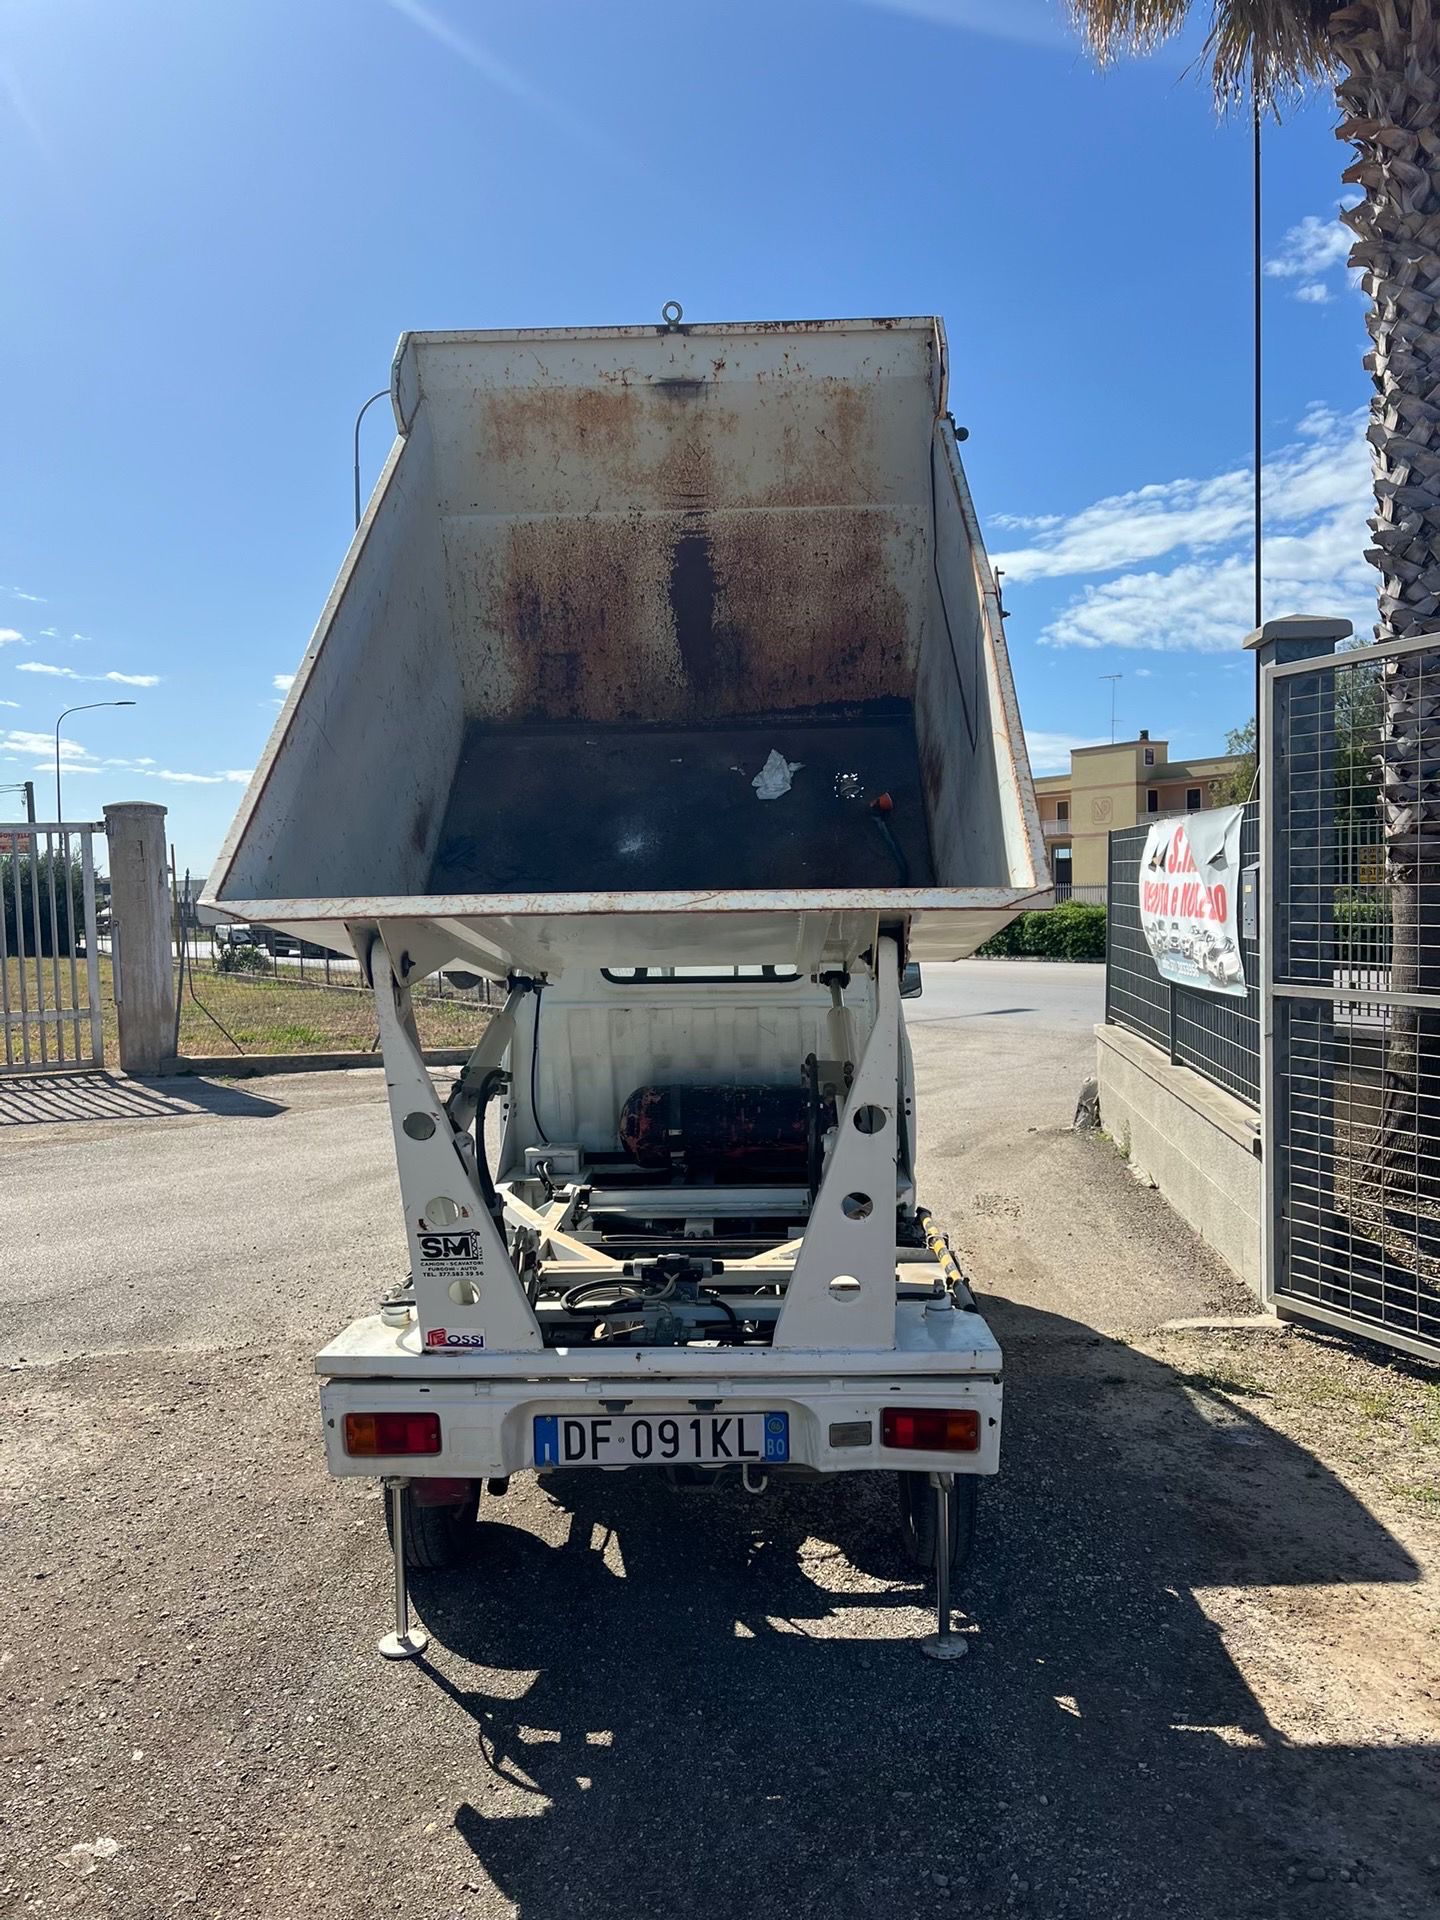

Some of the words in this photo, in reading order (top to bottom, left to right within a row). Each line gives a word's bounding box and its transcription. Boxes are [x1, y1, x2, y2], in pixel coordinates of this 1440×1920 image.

[1171, 885, 1179, 917] e
[564, 1419, 612, 1460] DF
[631, 1418, 760, 1459] 091KL
[767, 1438, 785, 1456] BO
